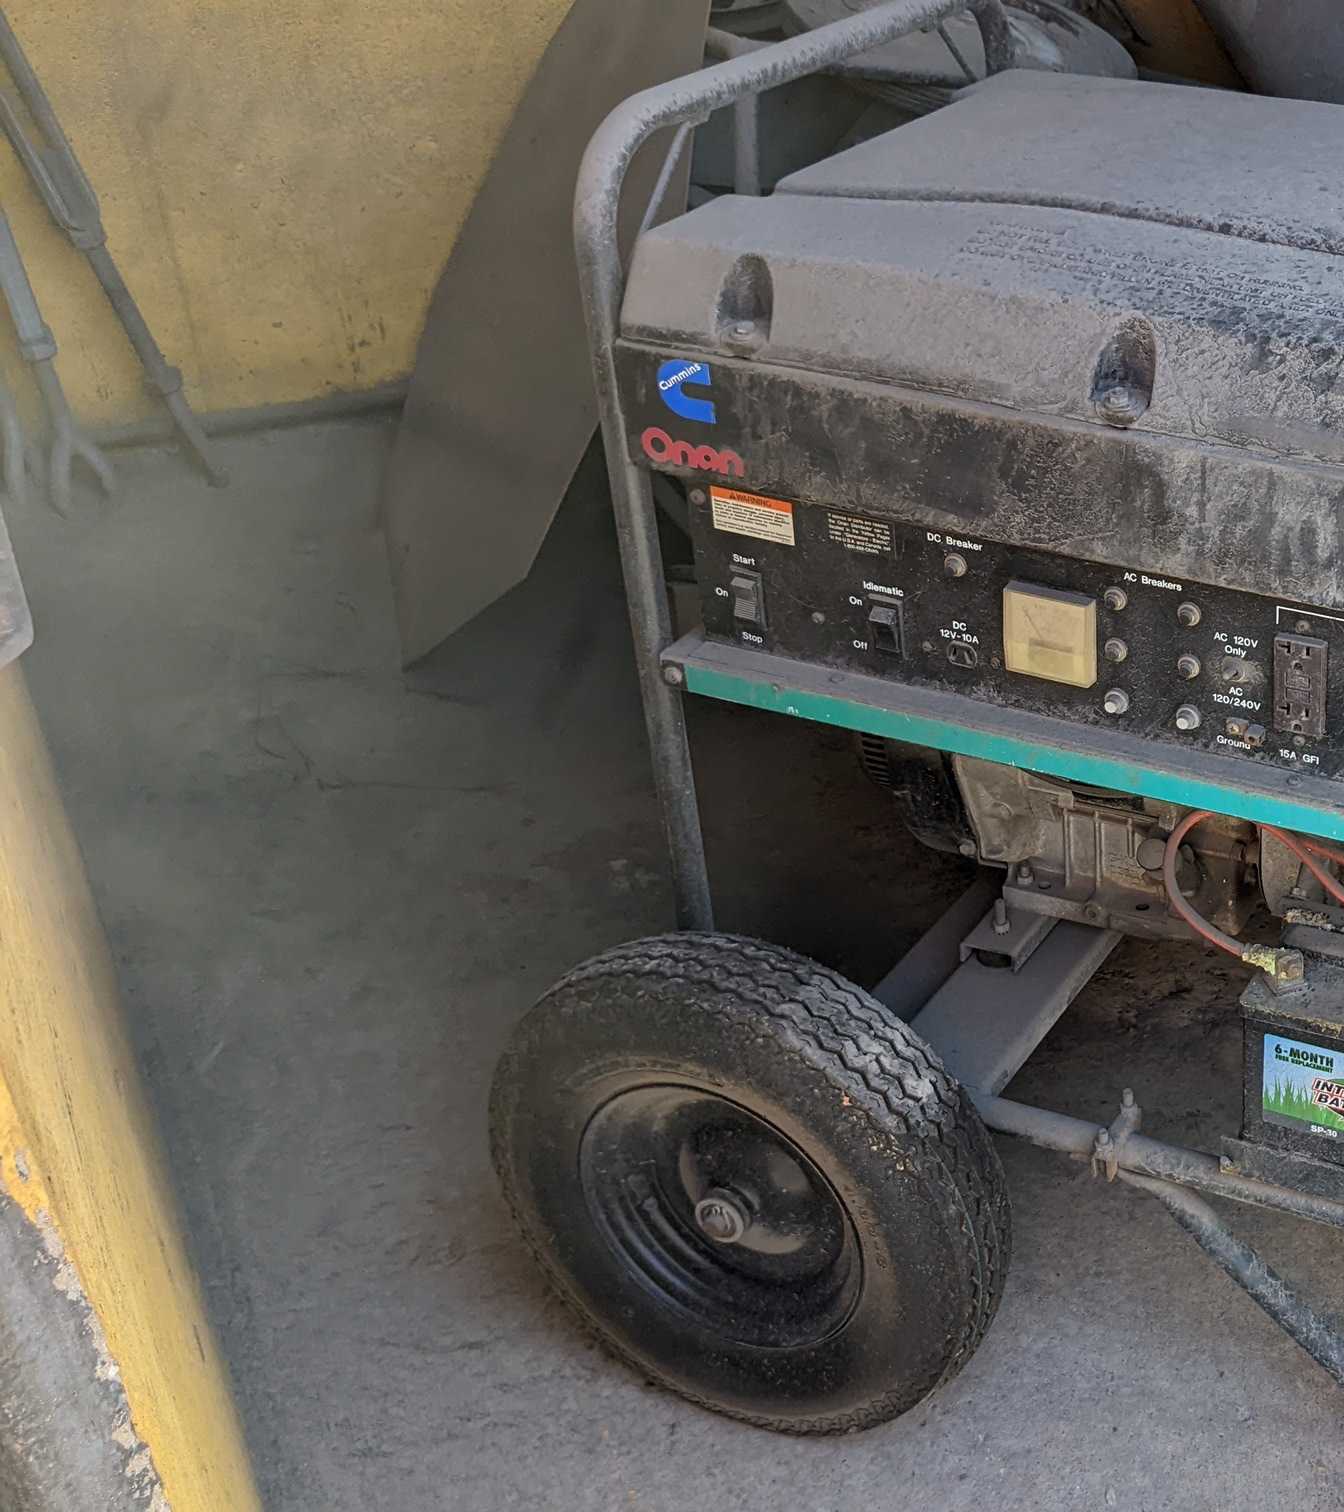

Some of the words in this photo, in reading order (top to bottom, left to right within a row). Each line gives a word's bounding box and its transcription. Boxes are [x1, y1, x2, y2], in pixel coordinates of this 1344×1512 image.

[659, 363, 702, 391] Cummins
[641, 427, 744, 477] Onan
[927, 532, 941, 544] DC
[946, 536, 983, 551] Breaker
[733, 553, 756, 566] Start
[863, 581, 904, 597] Idlematic
[1123, 572, 1138, 583] AC
[1141, 575, 1182, 592] Breakers
[715, 586, 729, 598] On
[849, 596, 863, 607] On
[952, 620, 967, 631] DC
[742, 631, 763, 644] Stop
[853, 639, 868, 650] Off
[940, 628, 980, 645] 12V-10A
[1213, 632, 1228, 642] AC
[1233, 636, 1258, 648] 120V
[1224, 645, 1247, 658] Only
[1228, 686, 1243, 697] AC
[1212, 693, 1261, 711] 120/240V
[1216, 734, 1251, 751] Ground
[1279, 749, 1297, 760] 15A
[1302, 754, 1320, 765] GFI
[1274, 1043, 1334, 1067] 6-MONTH
[1311, 1125, 1338, 1138] SP-30
